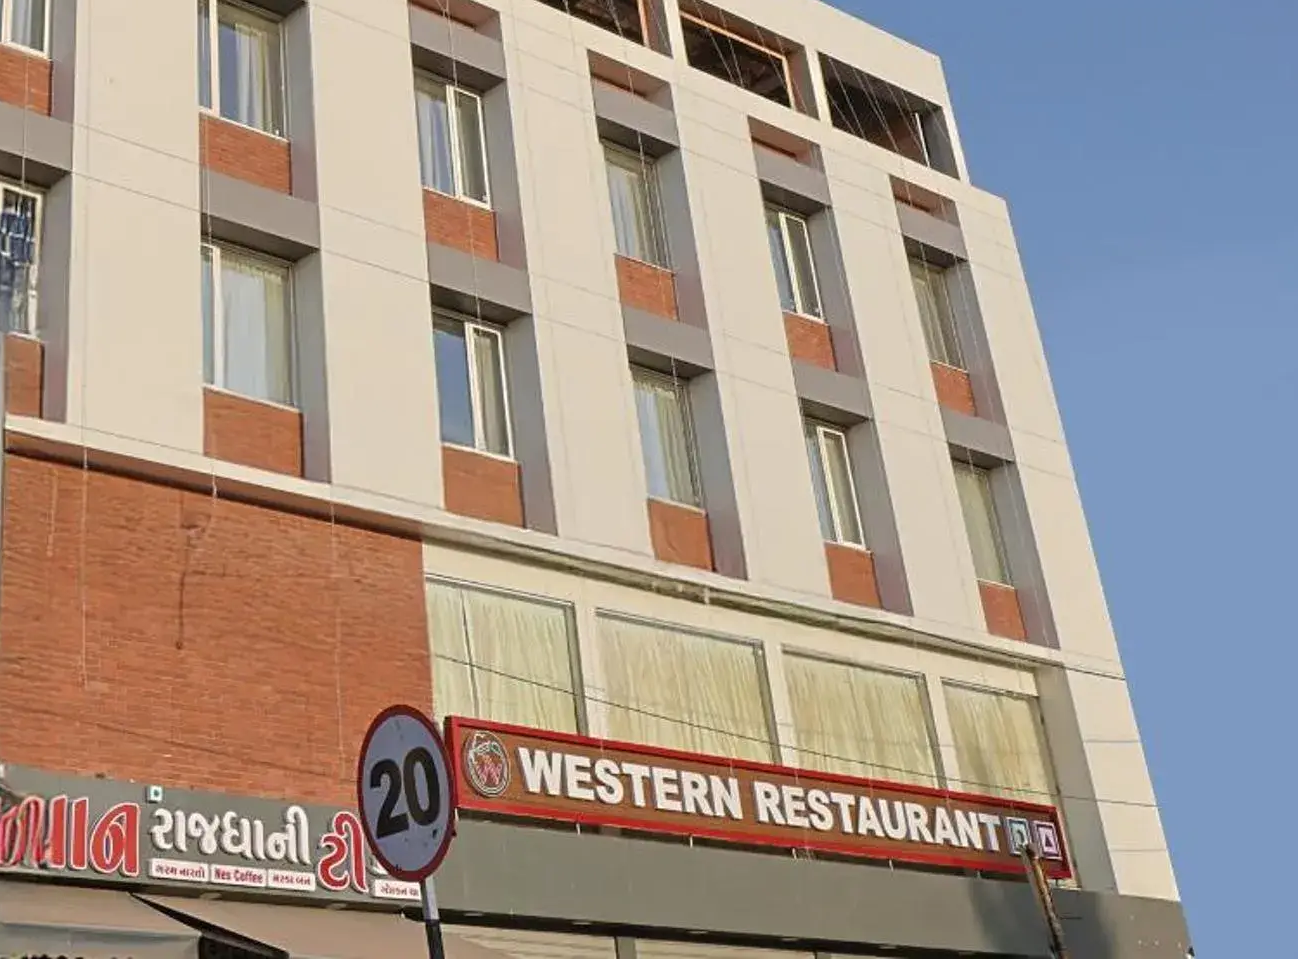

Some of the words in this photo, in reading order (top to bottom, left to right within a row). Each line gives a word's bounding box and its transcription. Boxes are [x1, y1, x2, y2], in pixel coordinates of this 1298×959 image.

[369, 744, 441, 840] 20
[515, 746, 744, 821] WESTERN
[753, 781, 1001, 853] RESTAURANT
[150, 805, 311, 864] રાજધાની
[214, 869, 231, 880] Nes
[233, 870, 263, 884] Coffee
